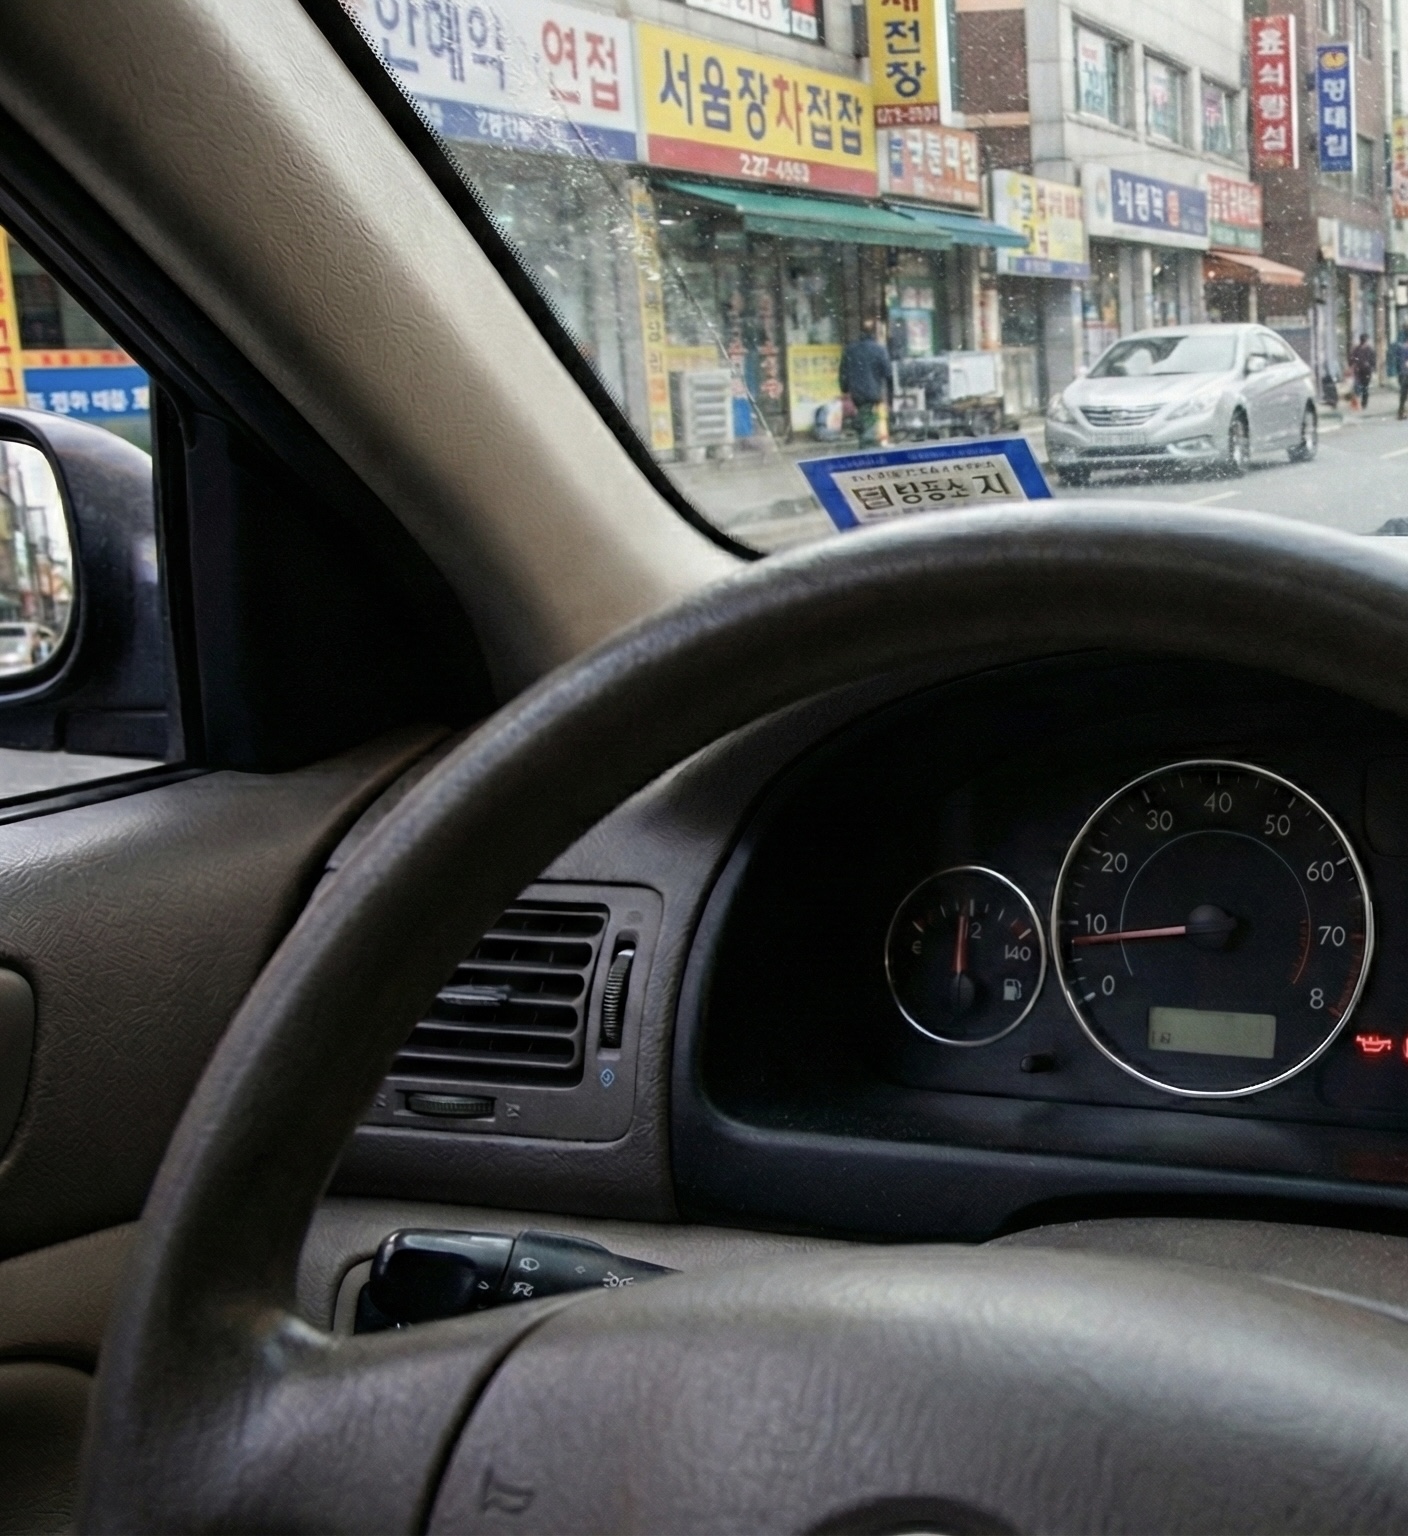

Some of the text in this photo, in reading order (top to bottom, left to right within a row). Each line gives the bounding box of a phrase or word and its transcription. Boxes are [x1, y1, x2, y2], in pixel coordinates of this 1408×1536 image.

[881, 0, 927, 98] 전장
[1203, 792, 1233, 814] 40
[1145, 810, 1173, 831] 30
[1264, 814, 1291, 837] 50
[1101, 852, 1128, 874] 20
[1306, 861, 1335, 883] 60
[1084, 913, 1107, 934] 10
[1318, 926, 1346, 947] 70
[1004, 944, 1031, 962] 140
[1101, 975, 1115, 996] 0
[1309, 988, 1324, 1010] 8
